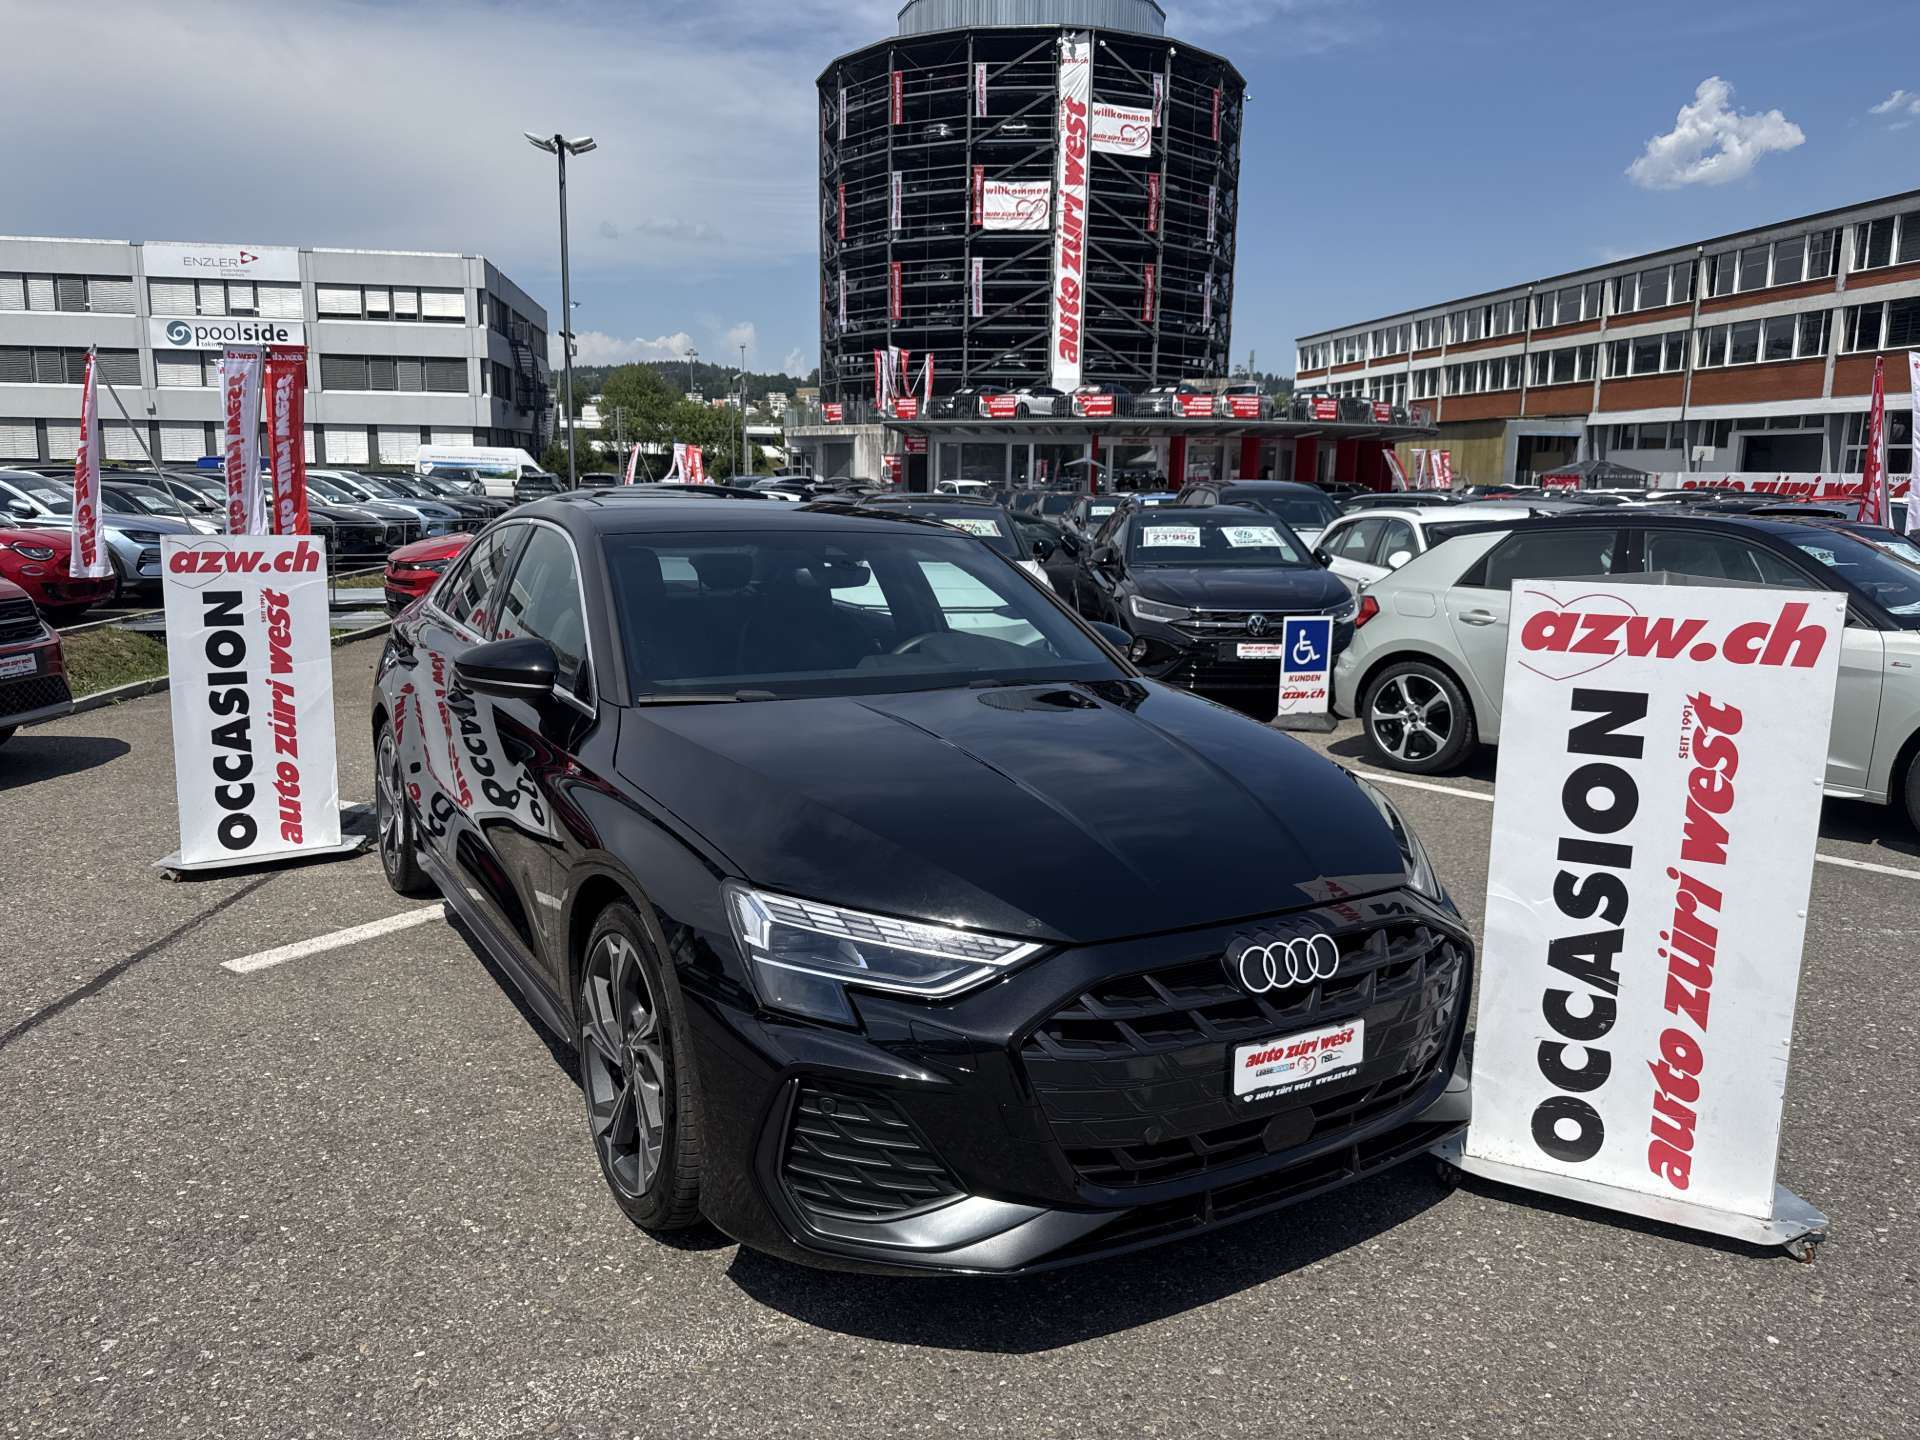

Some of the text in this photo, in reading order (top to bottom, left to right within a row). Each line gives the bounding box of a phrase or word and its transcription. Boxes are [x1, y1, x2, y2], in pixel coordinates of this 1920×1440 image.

[1093, 108, 1150, 122] willkommen
[985, 185, 1049, 195] willkommen
[1056, 95, 1087, 364] auto züri west
[183, 256, 239, 268] ENZLER
[195, 322, 288, 347] poolside
[168, 540, 321, 574] azw.ch
[1520, 602, 1828, 669] azw.ch
[1281, 687, 1326, 700] azw.ch
[1288, 674, 1322, 683] KUNDEN
[202, 590, 258, 851] OCCASION
[261, 587, 304, 845] auto züri west
[1677, 704, 1693, 760] SEIT 1991
[1530, 687, 1650, 1163] OCCASION
[1647, 691, 1744, 1191] auto züri west
[1245, 1028, 1355, 1068] auto züri west
[1255, 1089, 1275, 1100] auto
[1275, 1084, 1293, 1096] züri
[1294, 1080, 1313, 1091] west
